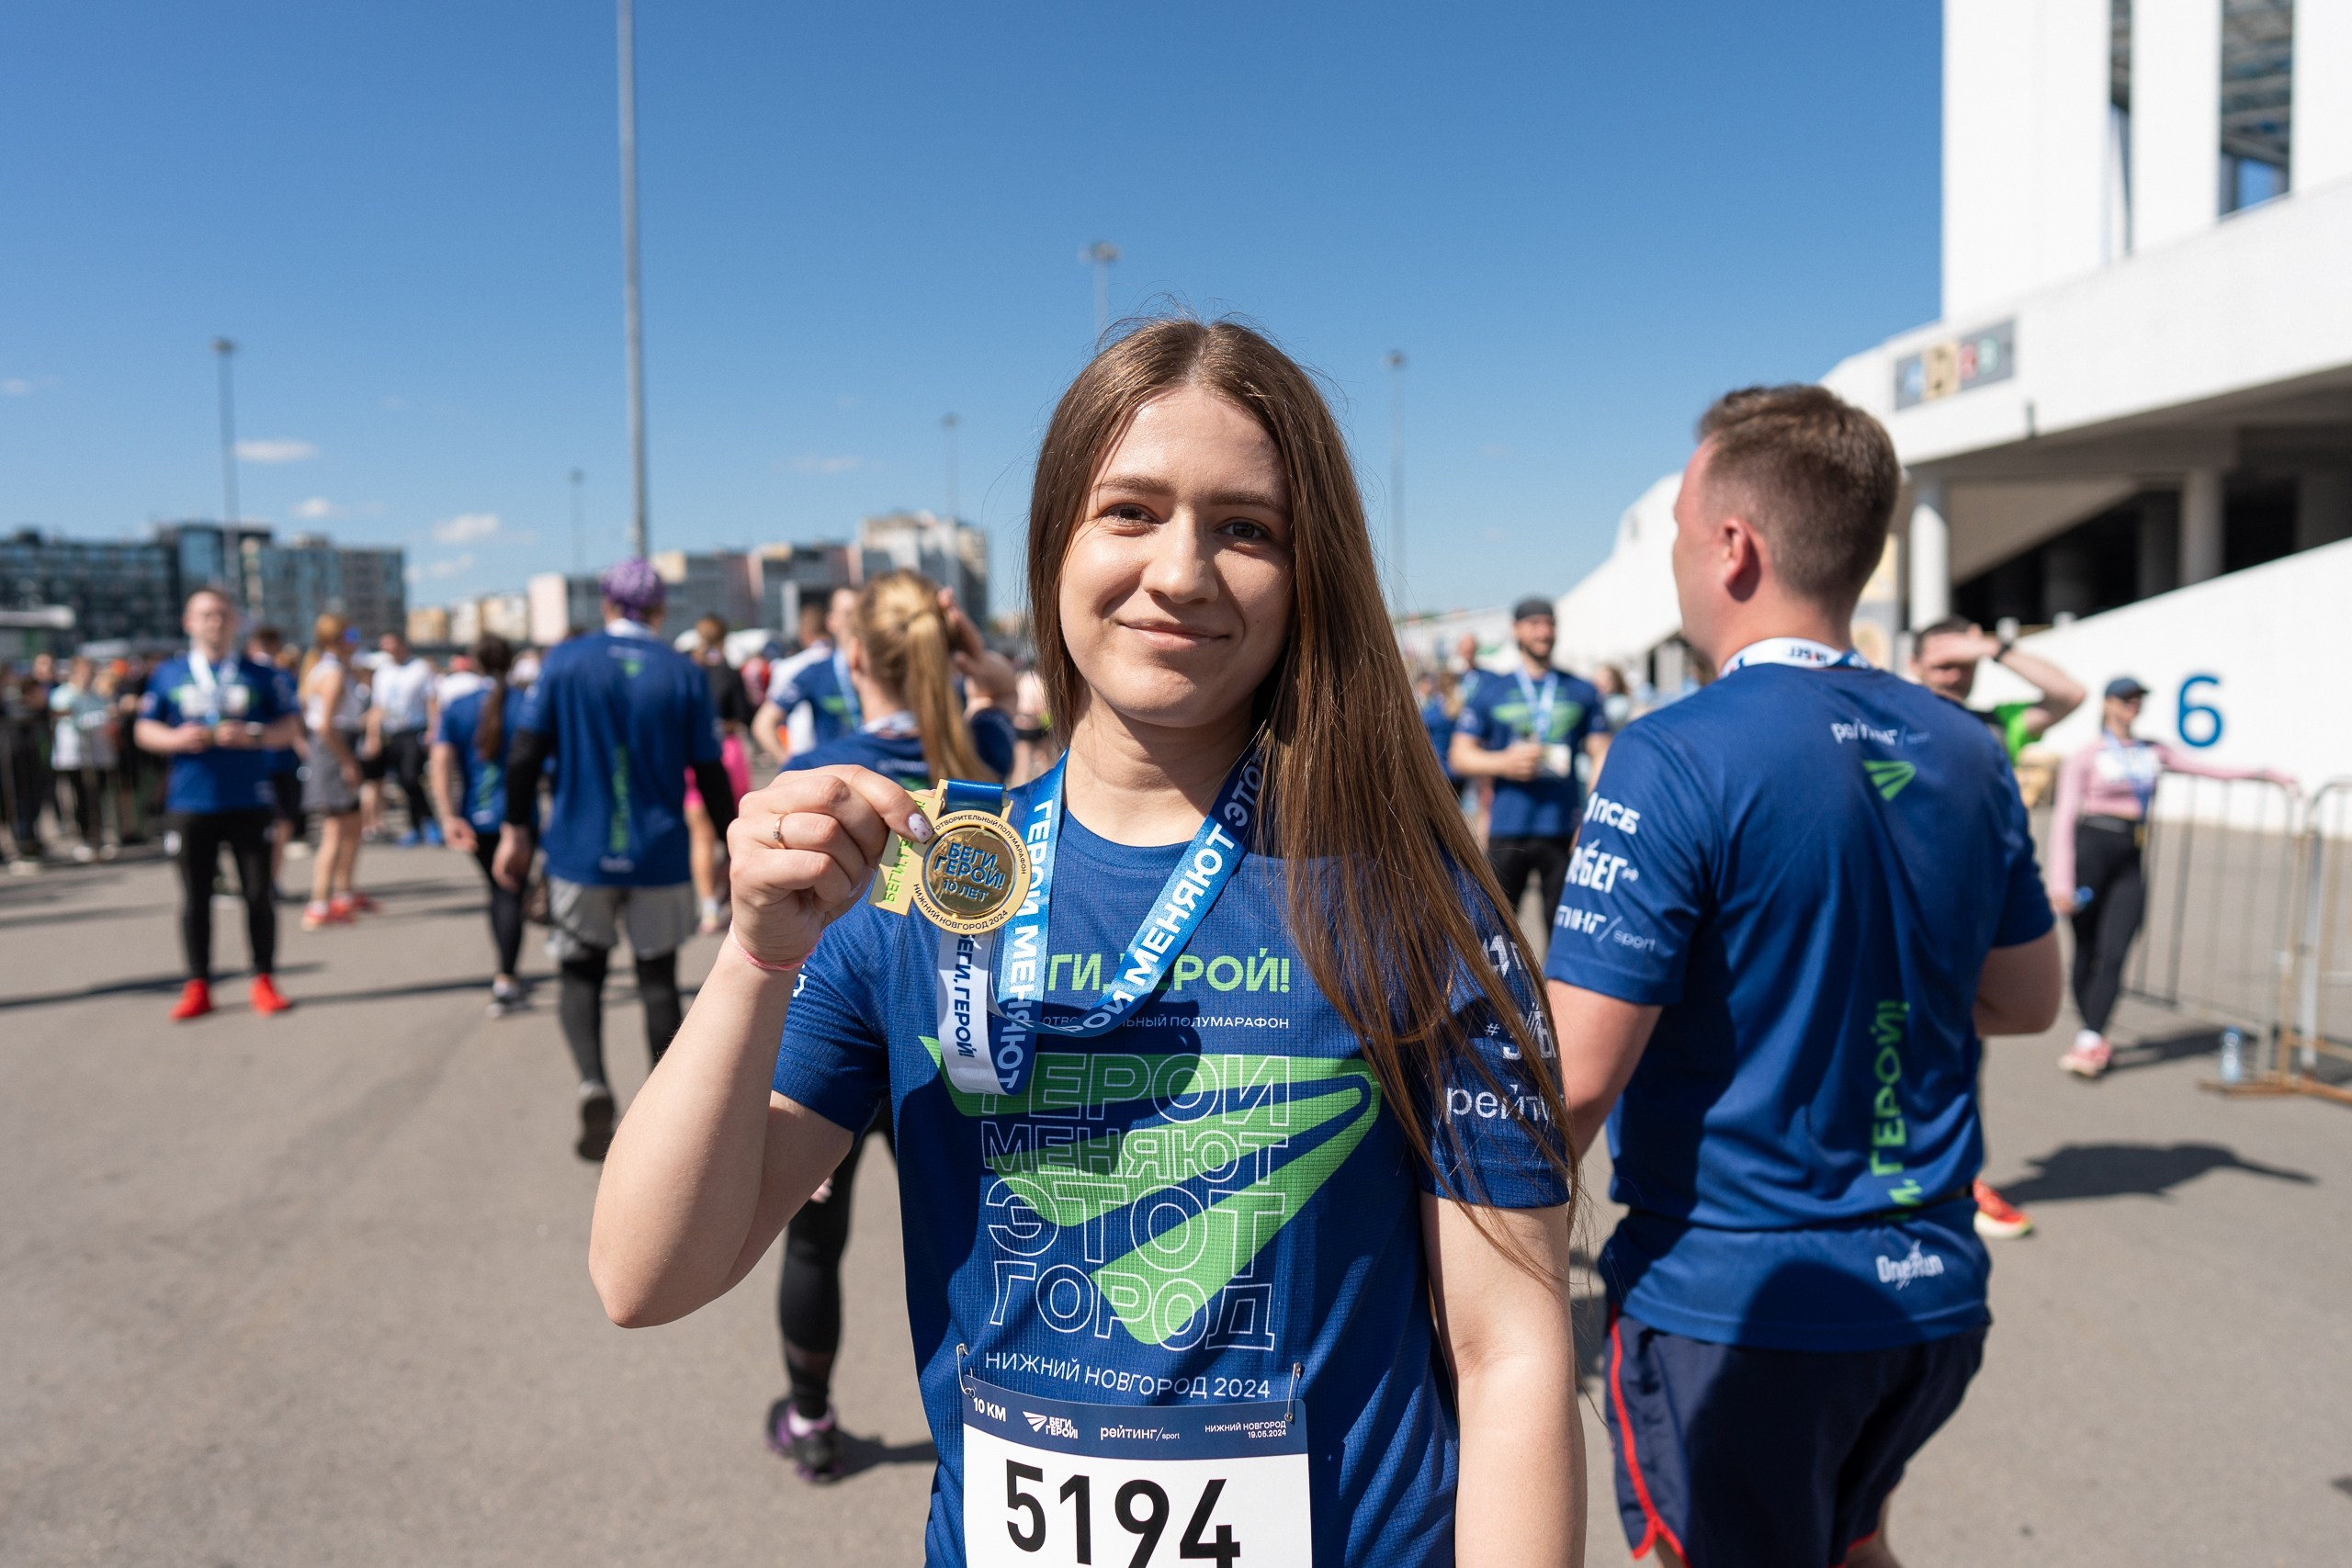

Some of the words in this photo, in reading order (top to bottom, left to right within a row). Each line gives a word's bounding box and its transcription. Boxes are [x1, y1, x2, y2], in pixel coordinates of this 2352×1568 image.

[2178, 674, 2223, 749] 6
[933, 815, 999, 832] ОТВОРИТЕЛЬНЫЙ
[997, 823, 1027, 874] ПОЛУМАРАФОН
[947, 842, 999, 868] БЕГИ,
[934, 854, 1007, 891] ГЕРОЙ!
[942, 879, 958, 893] 10
[959, 883, 989, 903] ЛЕТ
[913, 883, 941, 920] НИЖНИЙ
[939, 916, 989, 931] НОВГОРОД
[989, 909, 1009, 926] 2024
[1124, 823, 1236, 987] МЕНЯЮТ
[1160, 948, 1291, 993] РОЙ!
[954, 987, 978, 1058] ГЕРОЙ!
[1170, 1016, 1290, 1029] ПОЛУМАРАФОН
[980, 1121, 1290, 1186] МЕНЯЮТ
[986, 1177, 1286, 1279] ЭТОТ
[989, 1260, 1276, 1351] ГОРОД
[985, 1351, 1080, 1383] НИЖНИЙ
[1084, 1364, 1209, 1399] НОВГОРОД
[1214, 1378, 1271, 1399] 2024
[973, 1397, 986, 1415] 10
[987, 1402, 1007, 1422] КМ
[1046, 1427, 1079, 1439] ГЕРОЙ!
[1204, 1422, 1242, 1433] НИЖНИЙ
[1243, 1420, 1287, 1431] НОВГОРОД
[1247, 1429, 1287, 1439] 19.05.2024
[1006, 1459, 1241, 1568] 5194
